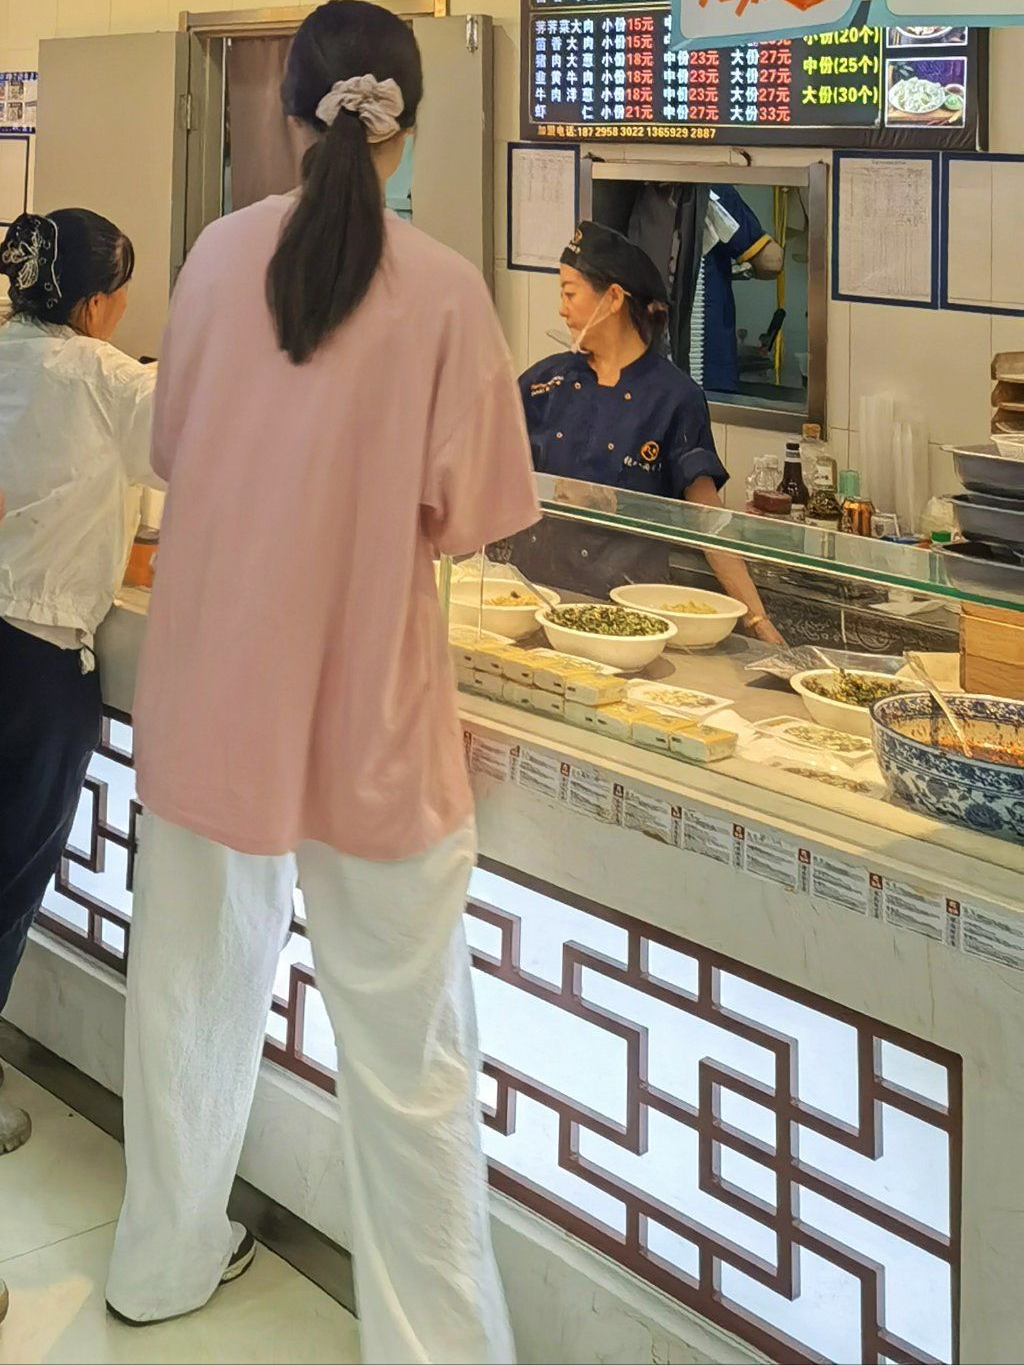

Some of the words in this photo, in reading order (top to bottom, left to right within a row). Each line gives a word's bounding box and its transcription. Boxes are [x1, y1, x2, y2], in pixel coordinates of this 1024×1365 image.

[602, 16, 654, 33] 小份15元
[601, 34, 653, 50] 小份15元
[601, 52, 653, 67] 小份18元
[663, 50, 719, 66] 中份23元
[730, 49, 792, 65] 大份27元
[803, 55, 879, 76] 中份(25个)
[601, 69, 653, 85] 小份18元
[663, 68, 719, 84] 中份23元
[730, 67, 792, 84] 大份27元
[601, 86, 653, 102] 小份18元
[663, 86, 719, 102] 中份23元
[730, 86, 791, 103] 大份27元
[802, 85, 879, 105] 大份(30个)
[601, 104, 654, 120] 小份21元
[663, 105, 719, 121] 中份27元
[730, 105, 791, 122] 大份33元
[620, 126, 644, 138] 3022
